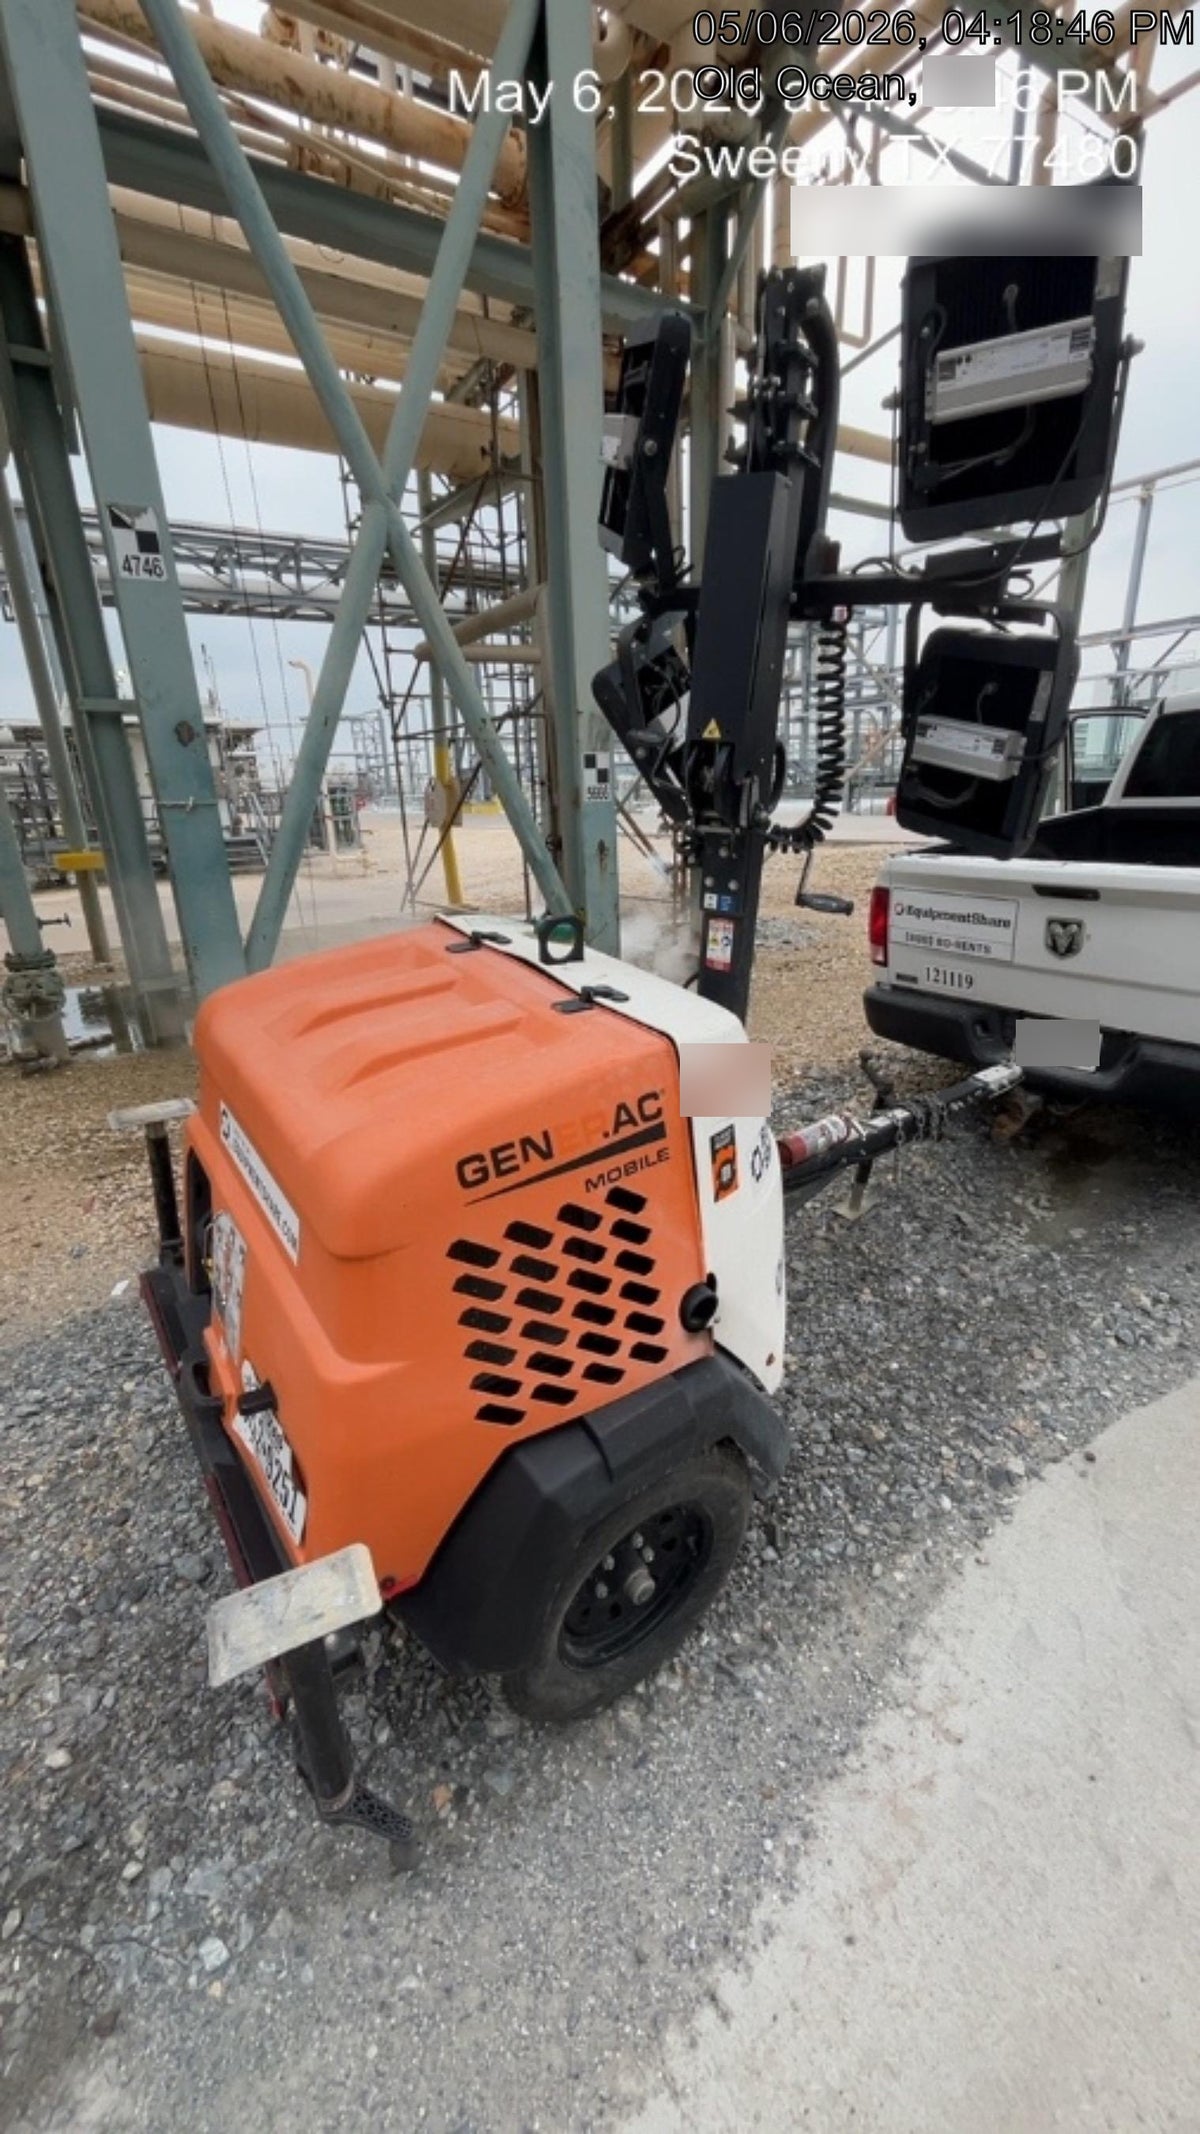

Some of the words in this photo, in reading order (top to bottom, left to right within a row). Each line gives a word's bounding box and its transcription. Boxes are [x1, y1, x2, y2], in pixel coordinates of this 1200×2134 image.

[122, 554, 164, 578] 4746
[906, 905, 1011, 928] EquipmentShare
[926, 967, 974, 989] 121119
[584, 1147, 671, 1193] MOBILE
